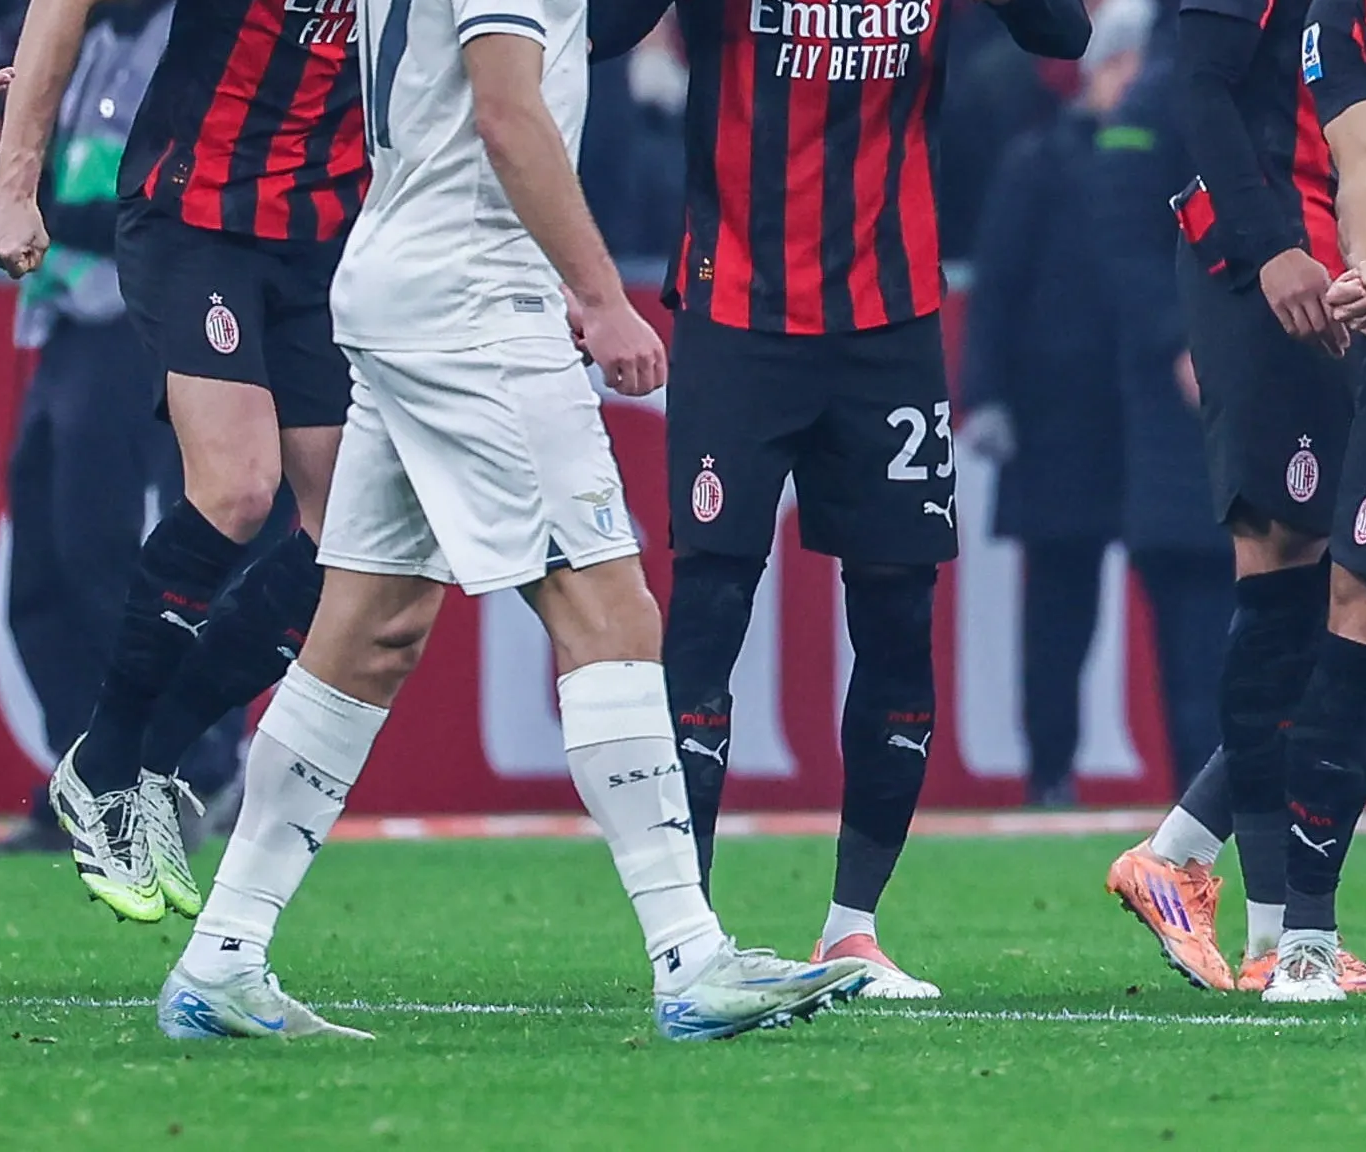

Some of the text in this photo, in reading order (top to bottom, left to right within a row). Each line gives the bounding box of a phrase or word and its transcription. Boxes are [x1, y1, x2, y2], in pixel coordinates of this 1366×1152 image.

[775, 43, 910, 81] FLY BETTER
[886, 400, 953, 480] 23
